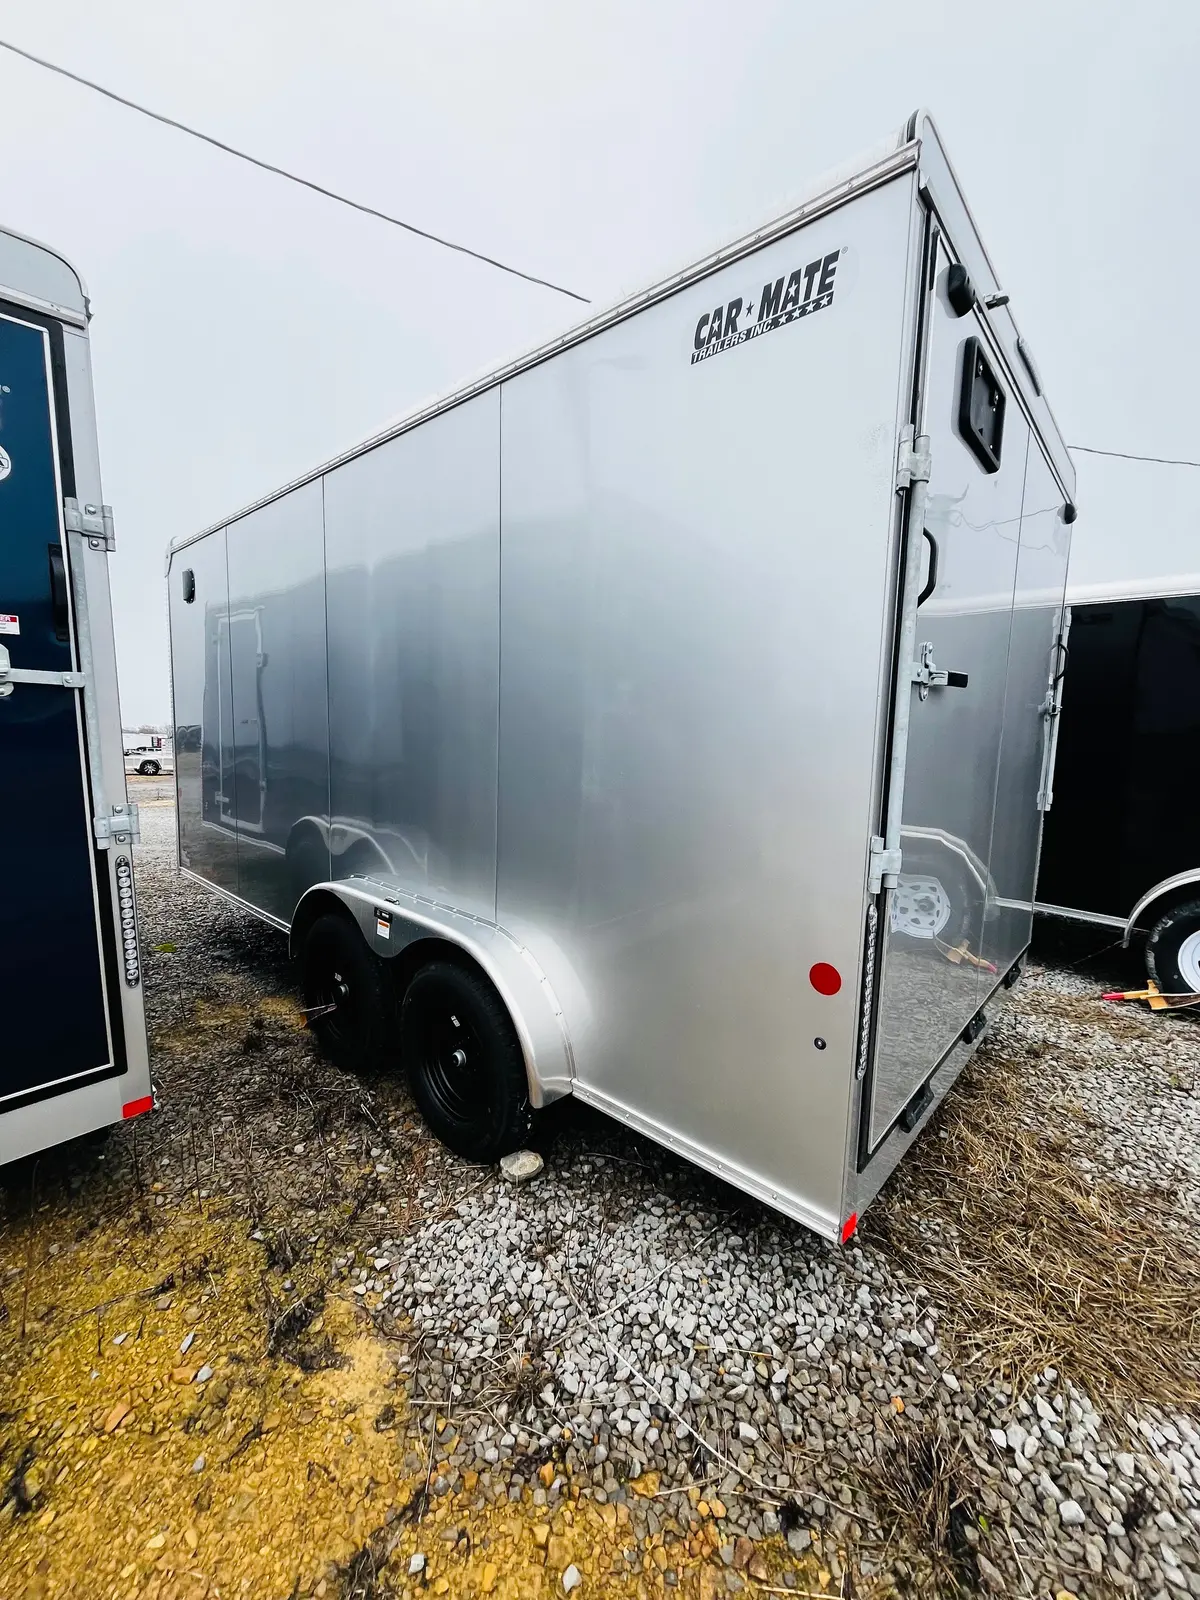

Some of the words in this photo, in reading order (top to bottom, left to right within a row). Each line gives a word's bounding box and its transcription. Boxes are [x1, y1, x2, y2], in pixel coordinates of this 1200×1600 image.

[694, 297, 743, 351] CAR
[757, 249, 841, 323] MATE
[692, 329, 747, 364] TRAILERS
[750, 319, 775, 338] INC.
